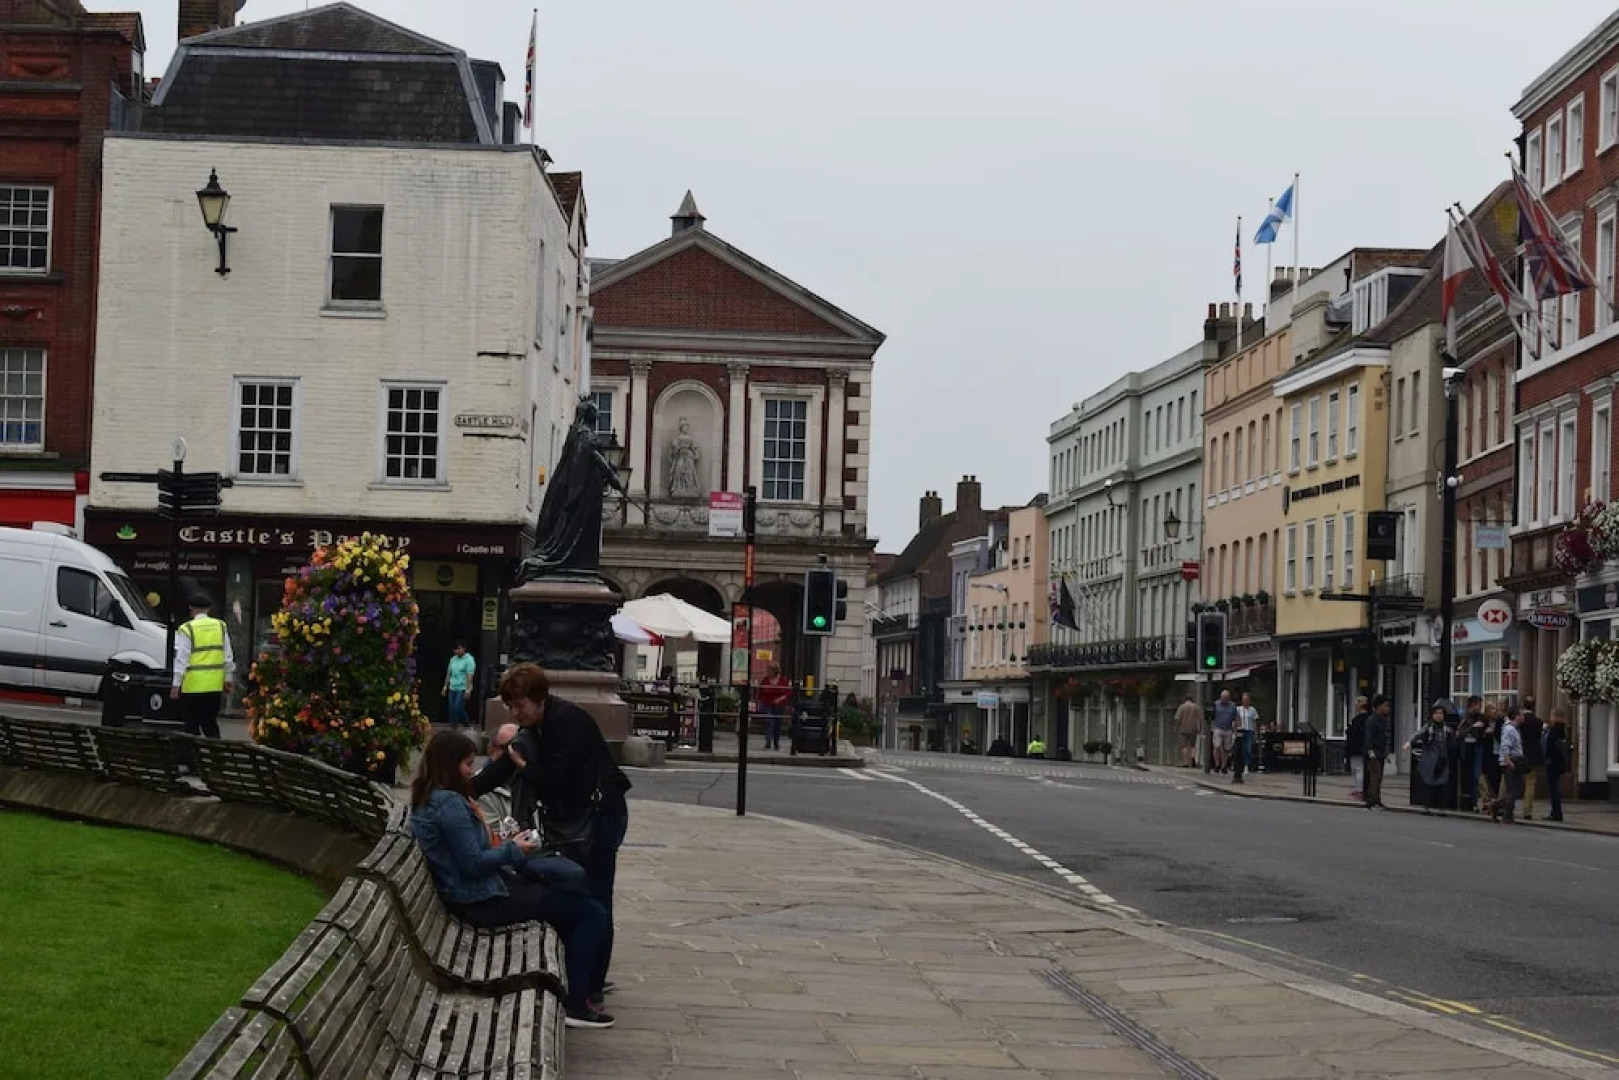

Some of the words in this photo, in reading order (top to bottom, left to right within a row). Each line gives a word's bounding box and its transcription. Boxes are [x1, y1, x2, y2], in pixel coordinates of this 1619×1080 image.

[178, 525, 295, 545] Castle's
[306, 529, 410, 549] Pary
[462, 544, 489, 554] Castle
[490, 546, 505, 554] Hill
[1531, 614, 1569, 627] BRITAIN
